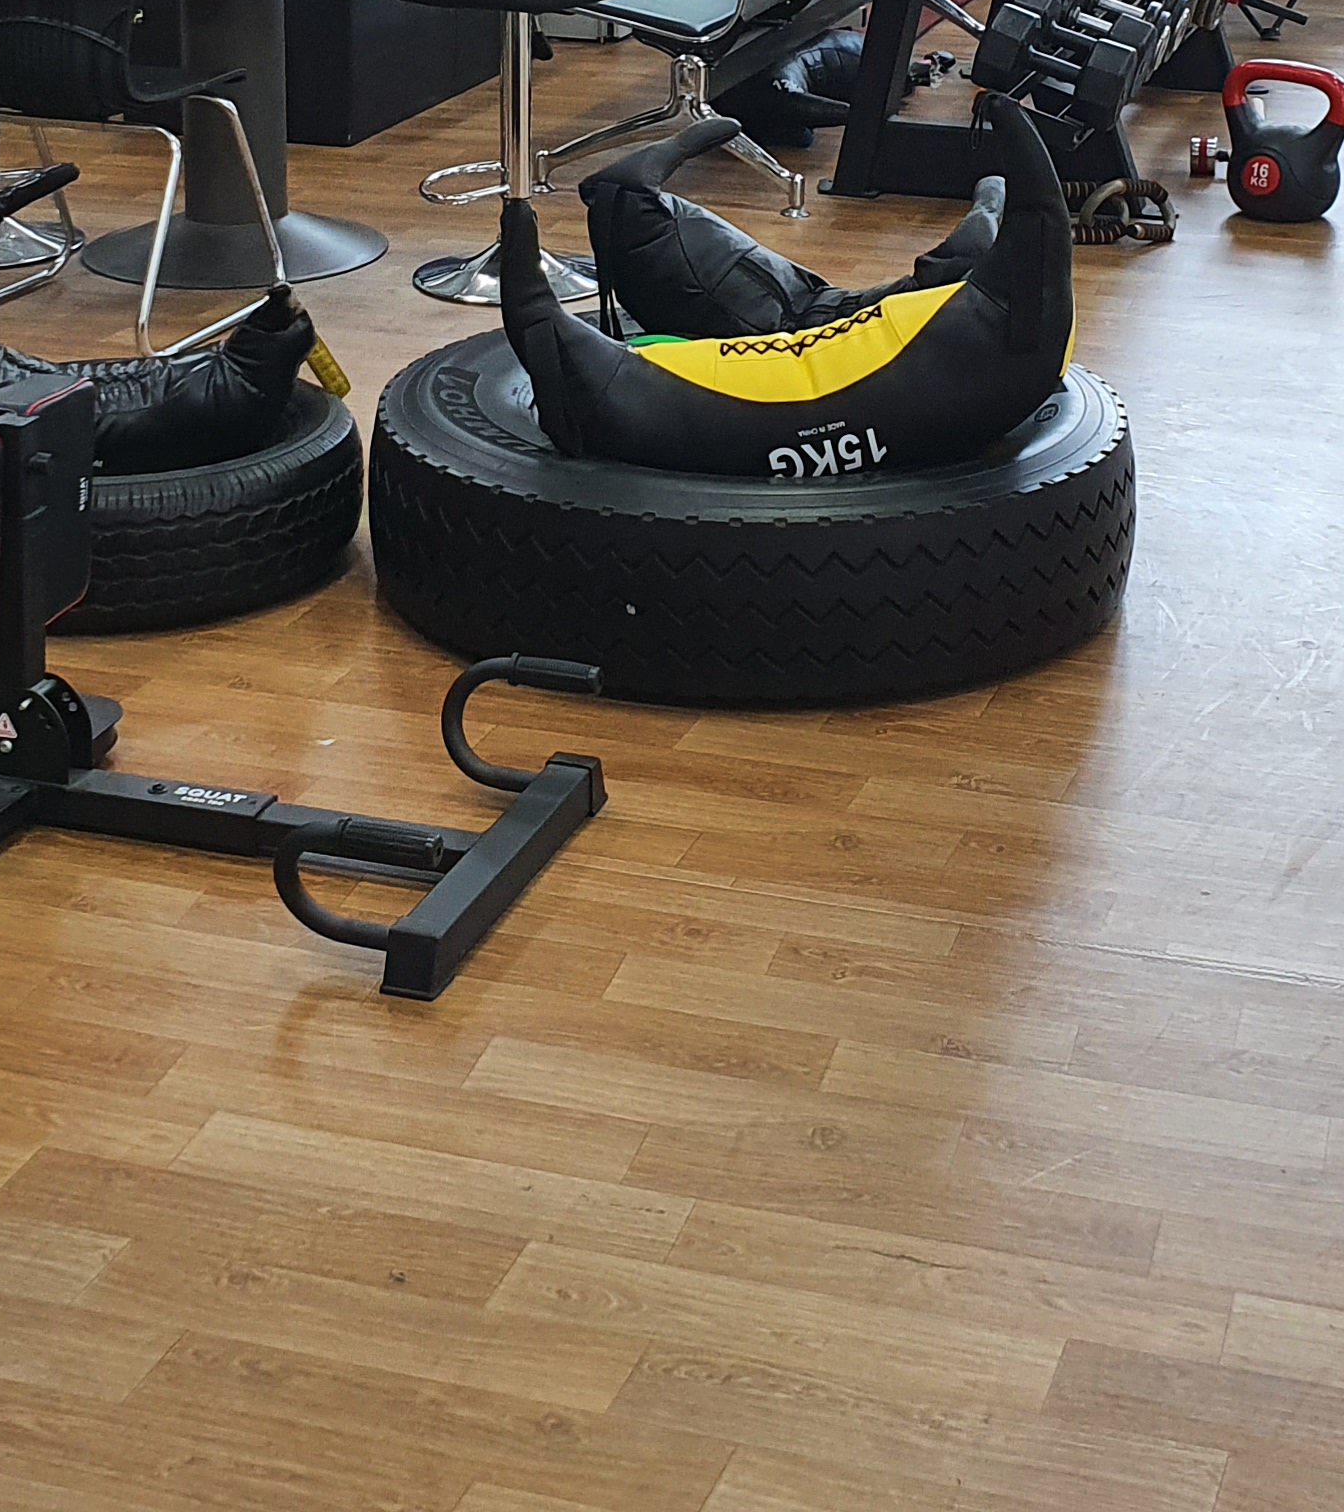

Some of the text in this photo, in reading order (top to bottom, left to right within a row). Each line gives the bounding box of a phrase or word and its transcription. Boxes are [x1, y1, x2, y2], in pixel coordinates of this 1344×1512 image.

[1251, 161, 1270, 178] 16
[1250, 176, 1268, 188] KG
[768, 428, 887, 479] 15KG
[173, 786, 248, 803] SQUAT
